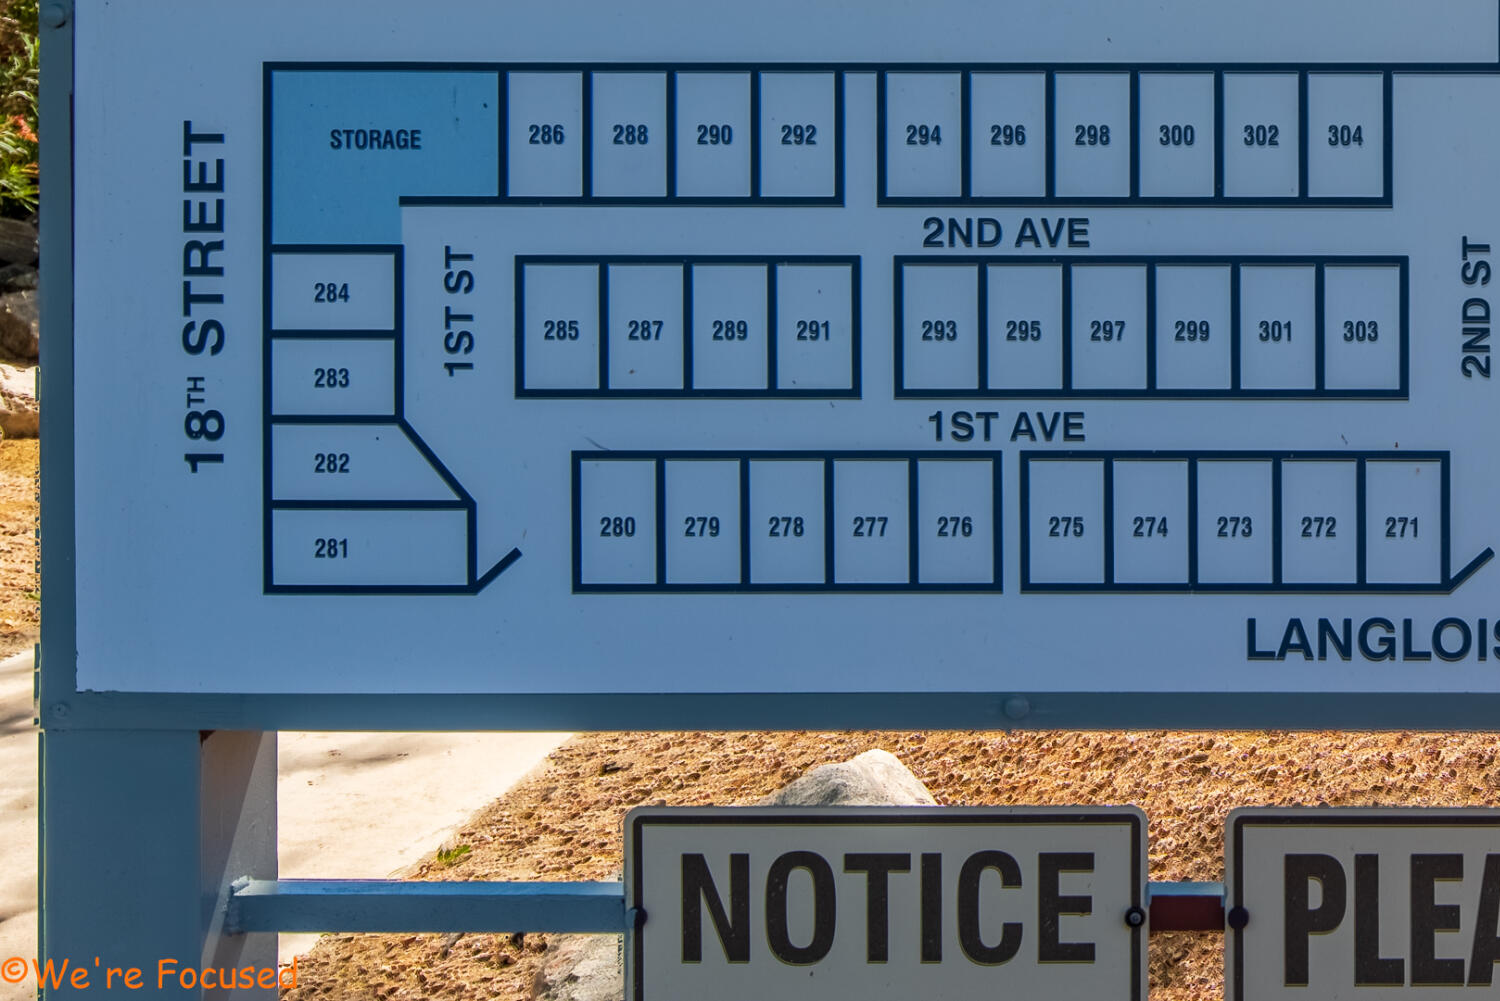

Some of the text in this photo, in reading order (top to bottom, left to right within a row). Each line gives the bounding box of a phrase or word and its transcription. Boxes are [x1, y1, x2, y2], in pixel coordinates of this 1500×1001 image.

[330, 128, 422, 151] STORAGE
[528, 124, 565, 145] 286
[612, 124, 649, 146] 288
[696, 124, 733, 146] 290
[781, 124, 817, 146] 292
[906, 124, 942, 146] 294
[990, 124, 1026, 146] 296
[1075, 124, 1111, 146] 298
[1159, 124, 1195, 146] 300
[1243, 124, 1280, 147] 302
[1327, 124, 1364, 147] 304
[181, 120, 226, 357] STREET
[922, 216, 1091, 249] 2ND AVE
[314, 282, 350, 303] 284
[443, 245, 475, 377] 1ST ST
[1460, 235, 1492, 379] 2ND ST
[543, 319, 580, 341] 285
[628, 319, 664, 341] 287
[712, 319, 748, 341] 289
[796, 320, 830, 341] 291
[921, 320, 958, 342] 293
[1006, 320, 1042, 342] 295
[1090, 320, 1126, 342] 297
[1174, 320, 1210, 342] 299
[1258, 320, 1292, 342] 301
[1343, 320, 1379, 343] 303
[314, 367, 350, 389] 283
[928, 410, 1086, 443] 1ST AVE
[314, 452, 350, 474] 282
[600, 516, 636, 538] 280
[684, 516, 720, 538] 279
[768, 516, 805, 538] 278
[853, 516, 889, 537] 277
[937, 516, 973, 538] 276
[1048, 516, 1085, 538] 275
[1133, 516, 1169, 538] 274
[1216, 516, 1253, 538] 273
[1301, 516, 1337, 538] 272
[1385, 516, 1418, 538] 271
[314, 538, 348, 559] 281
[680, 851, 1097, 967] NOTICE
